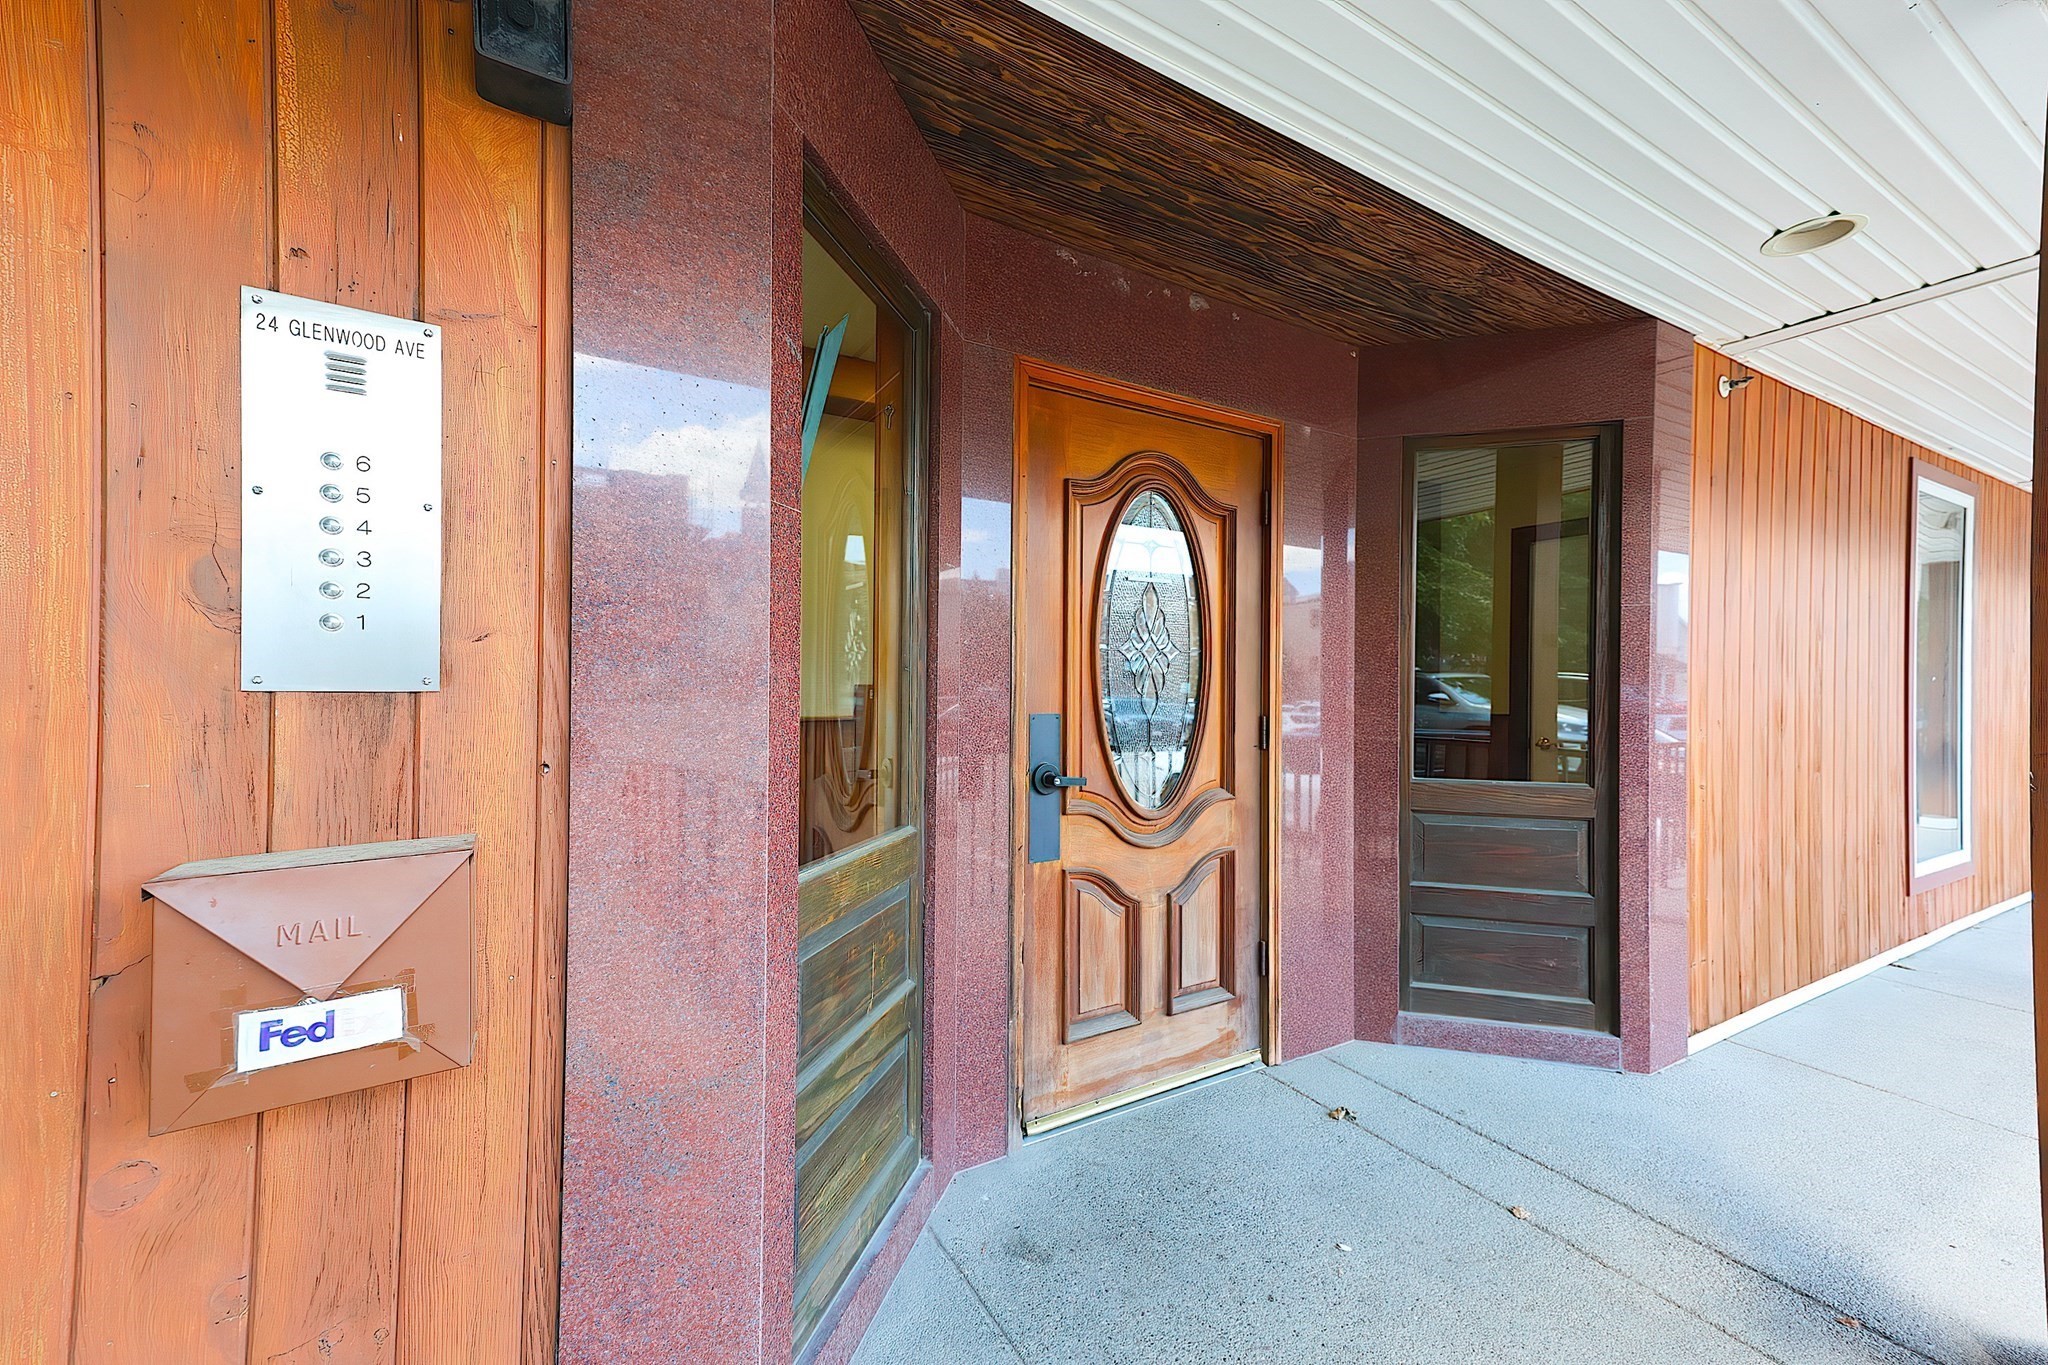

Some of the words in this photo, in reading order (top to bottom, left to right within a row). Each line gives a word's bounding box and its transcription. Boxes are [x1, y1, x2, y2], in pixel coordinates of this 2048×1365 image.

[256, 312, 279, 332] 24
[289, 318, 387, 352] GLENWOOD
[394, 340, 425, 360] AVE
[356, 455, 371, 472] 6
[356, 487, 371, 503] 5
[356, 519, 372, 535] 4
[356, 551, 372, 567] 3
[356, 583, 371, 599] 2
[356, 614, 366, 631] 1
[277, 915, 364, 947] MAIL
